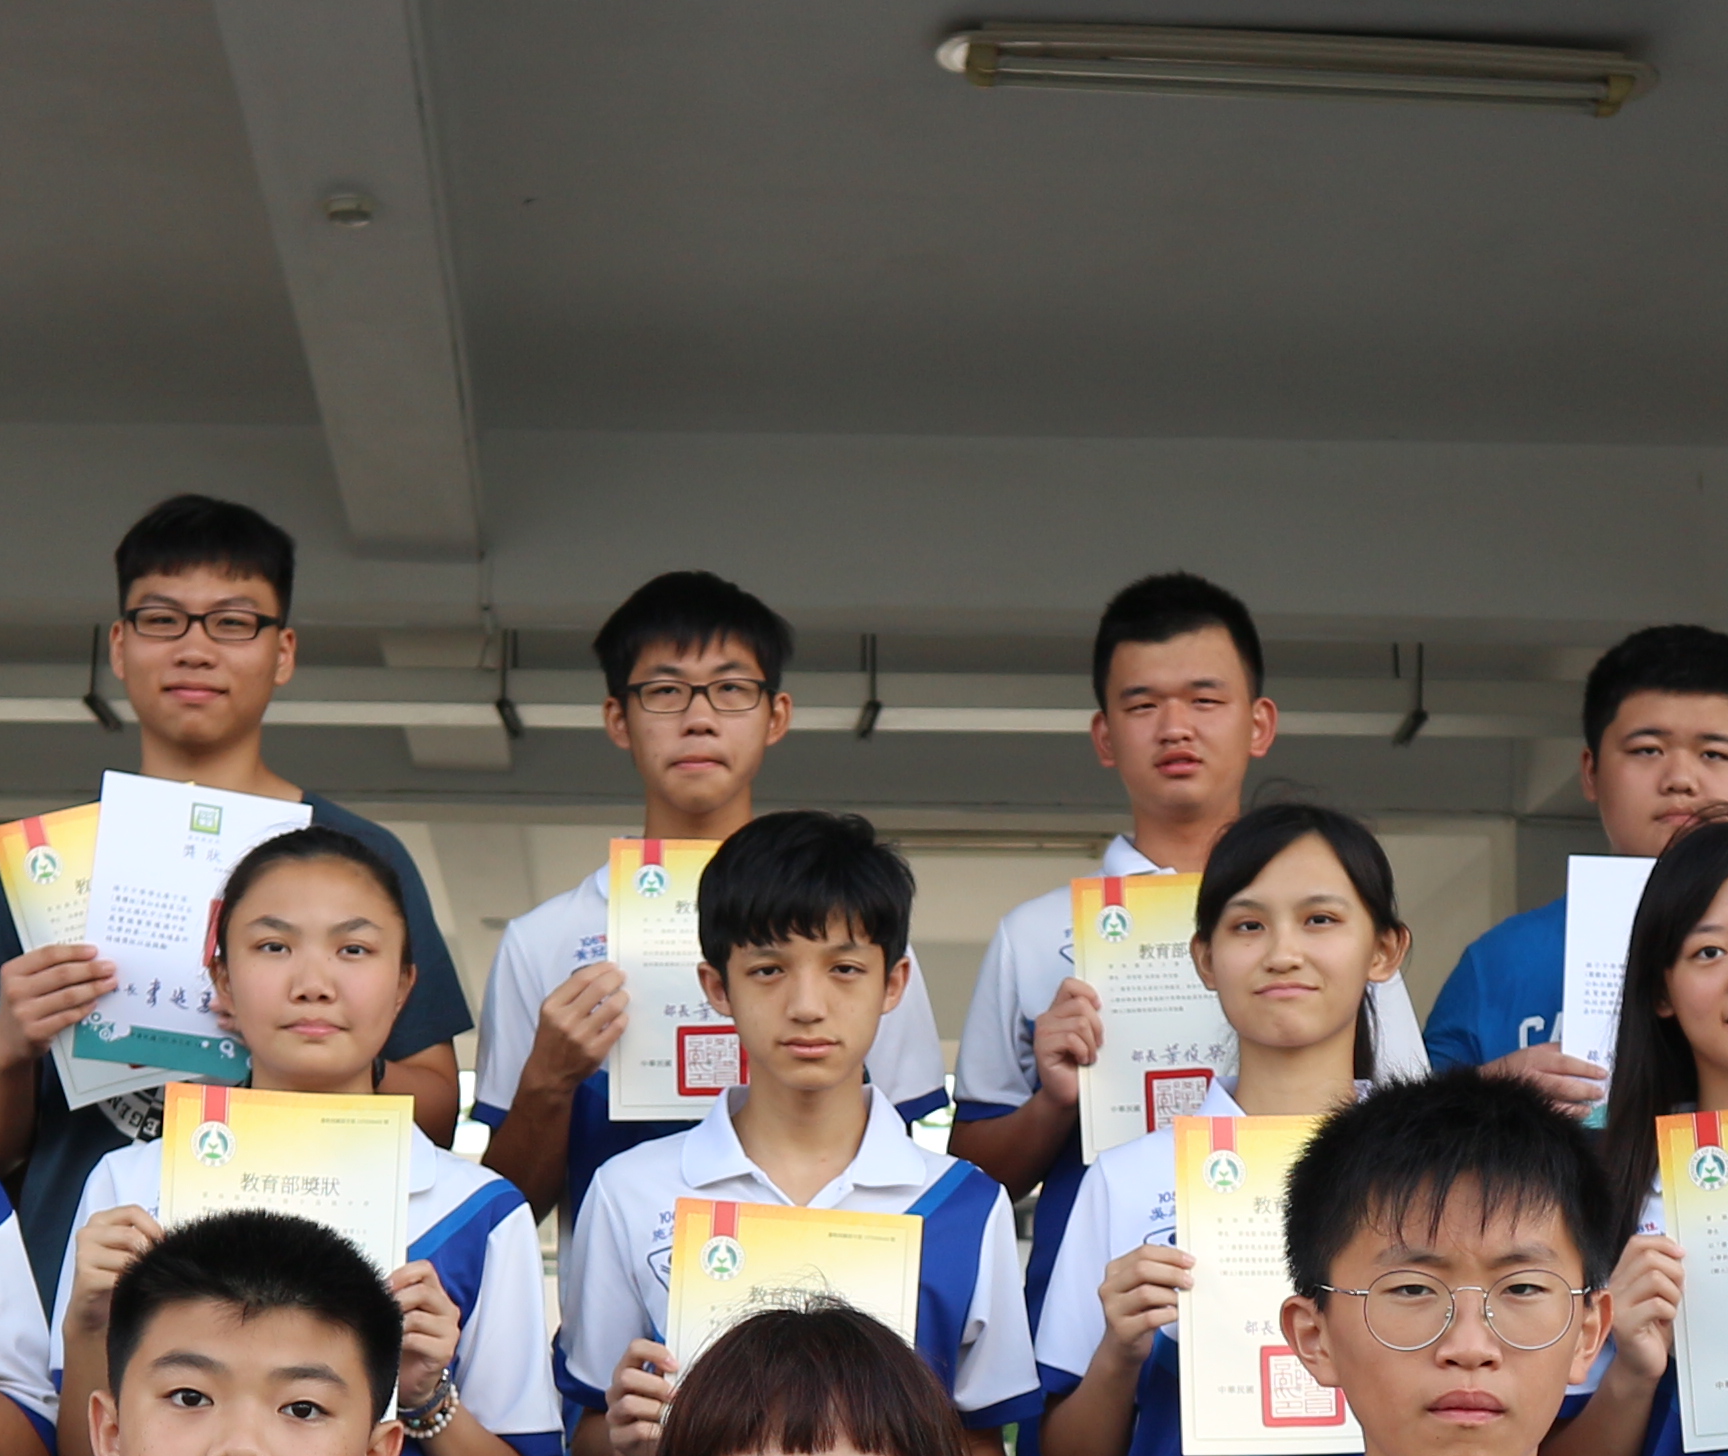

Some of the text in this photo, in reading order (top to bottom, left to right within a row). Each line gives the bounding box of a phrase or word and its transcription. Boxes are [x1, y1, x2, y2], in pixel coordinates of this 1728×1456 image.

[1138, 942, 1190, 961] 教育部
[240, 1171, 341, 1198] 教育部獎狀
